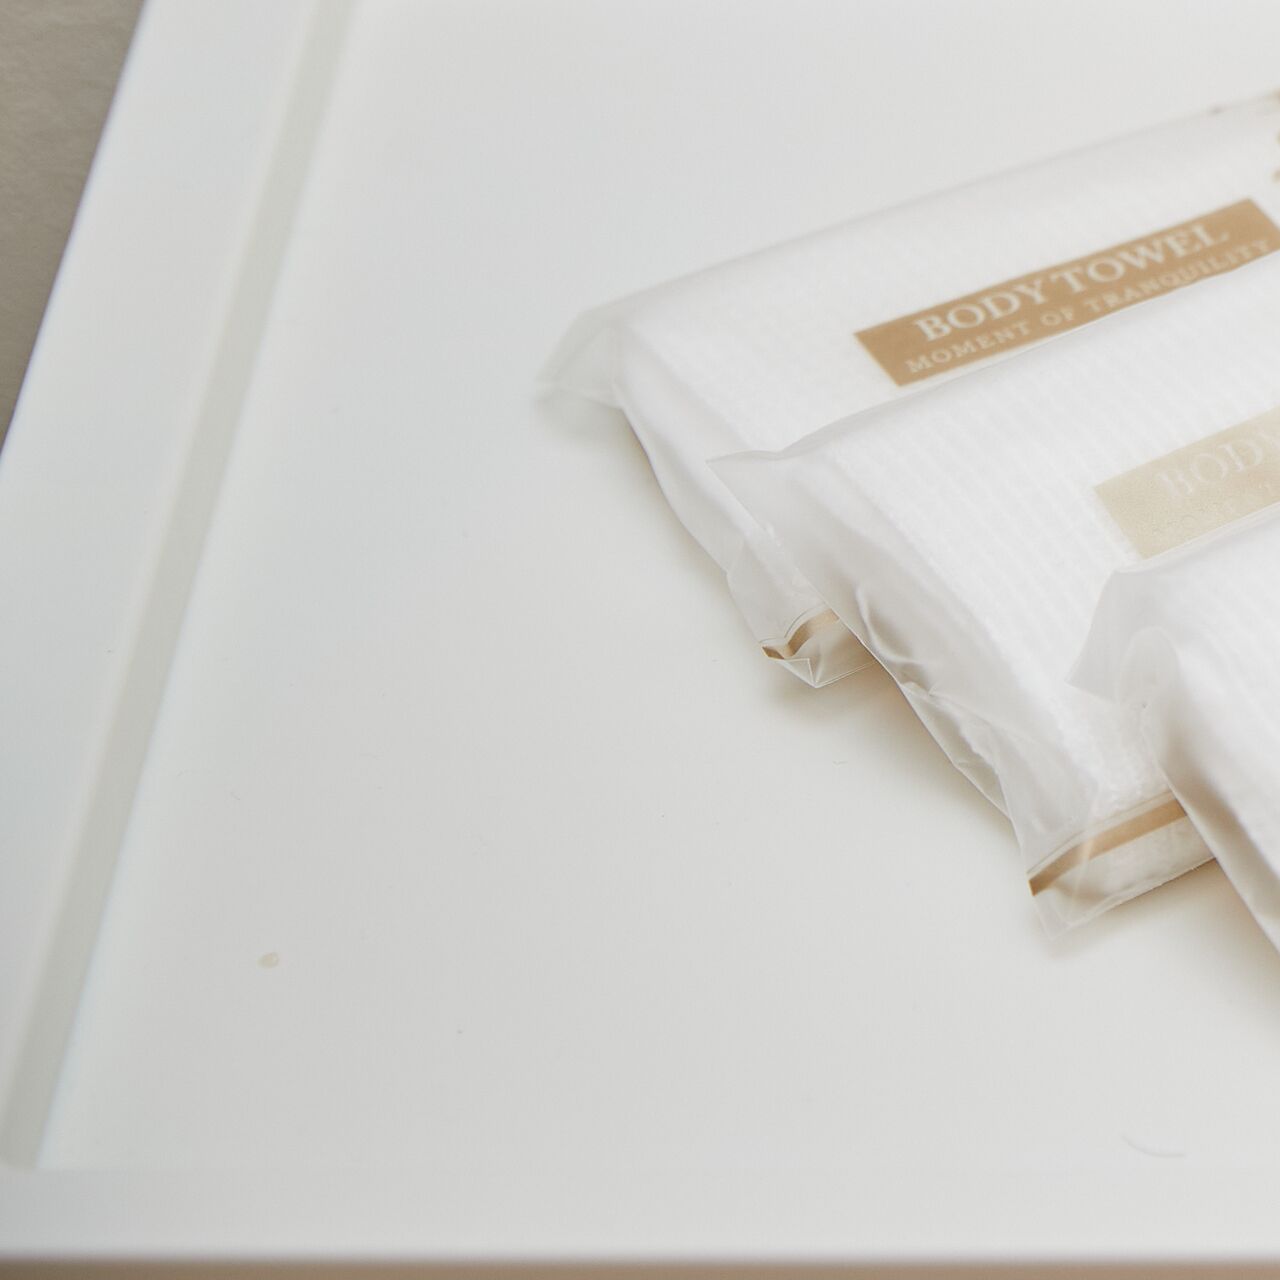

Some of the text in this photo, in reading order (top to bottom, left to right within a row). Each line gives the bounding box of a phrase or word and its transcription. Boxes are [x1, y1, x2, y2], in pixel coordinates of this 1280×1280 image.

[904, 238, 1273, 374] MOMENT OF TRANQUILITY
[913, 221, 1230, 343] BODY TOWEL
